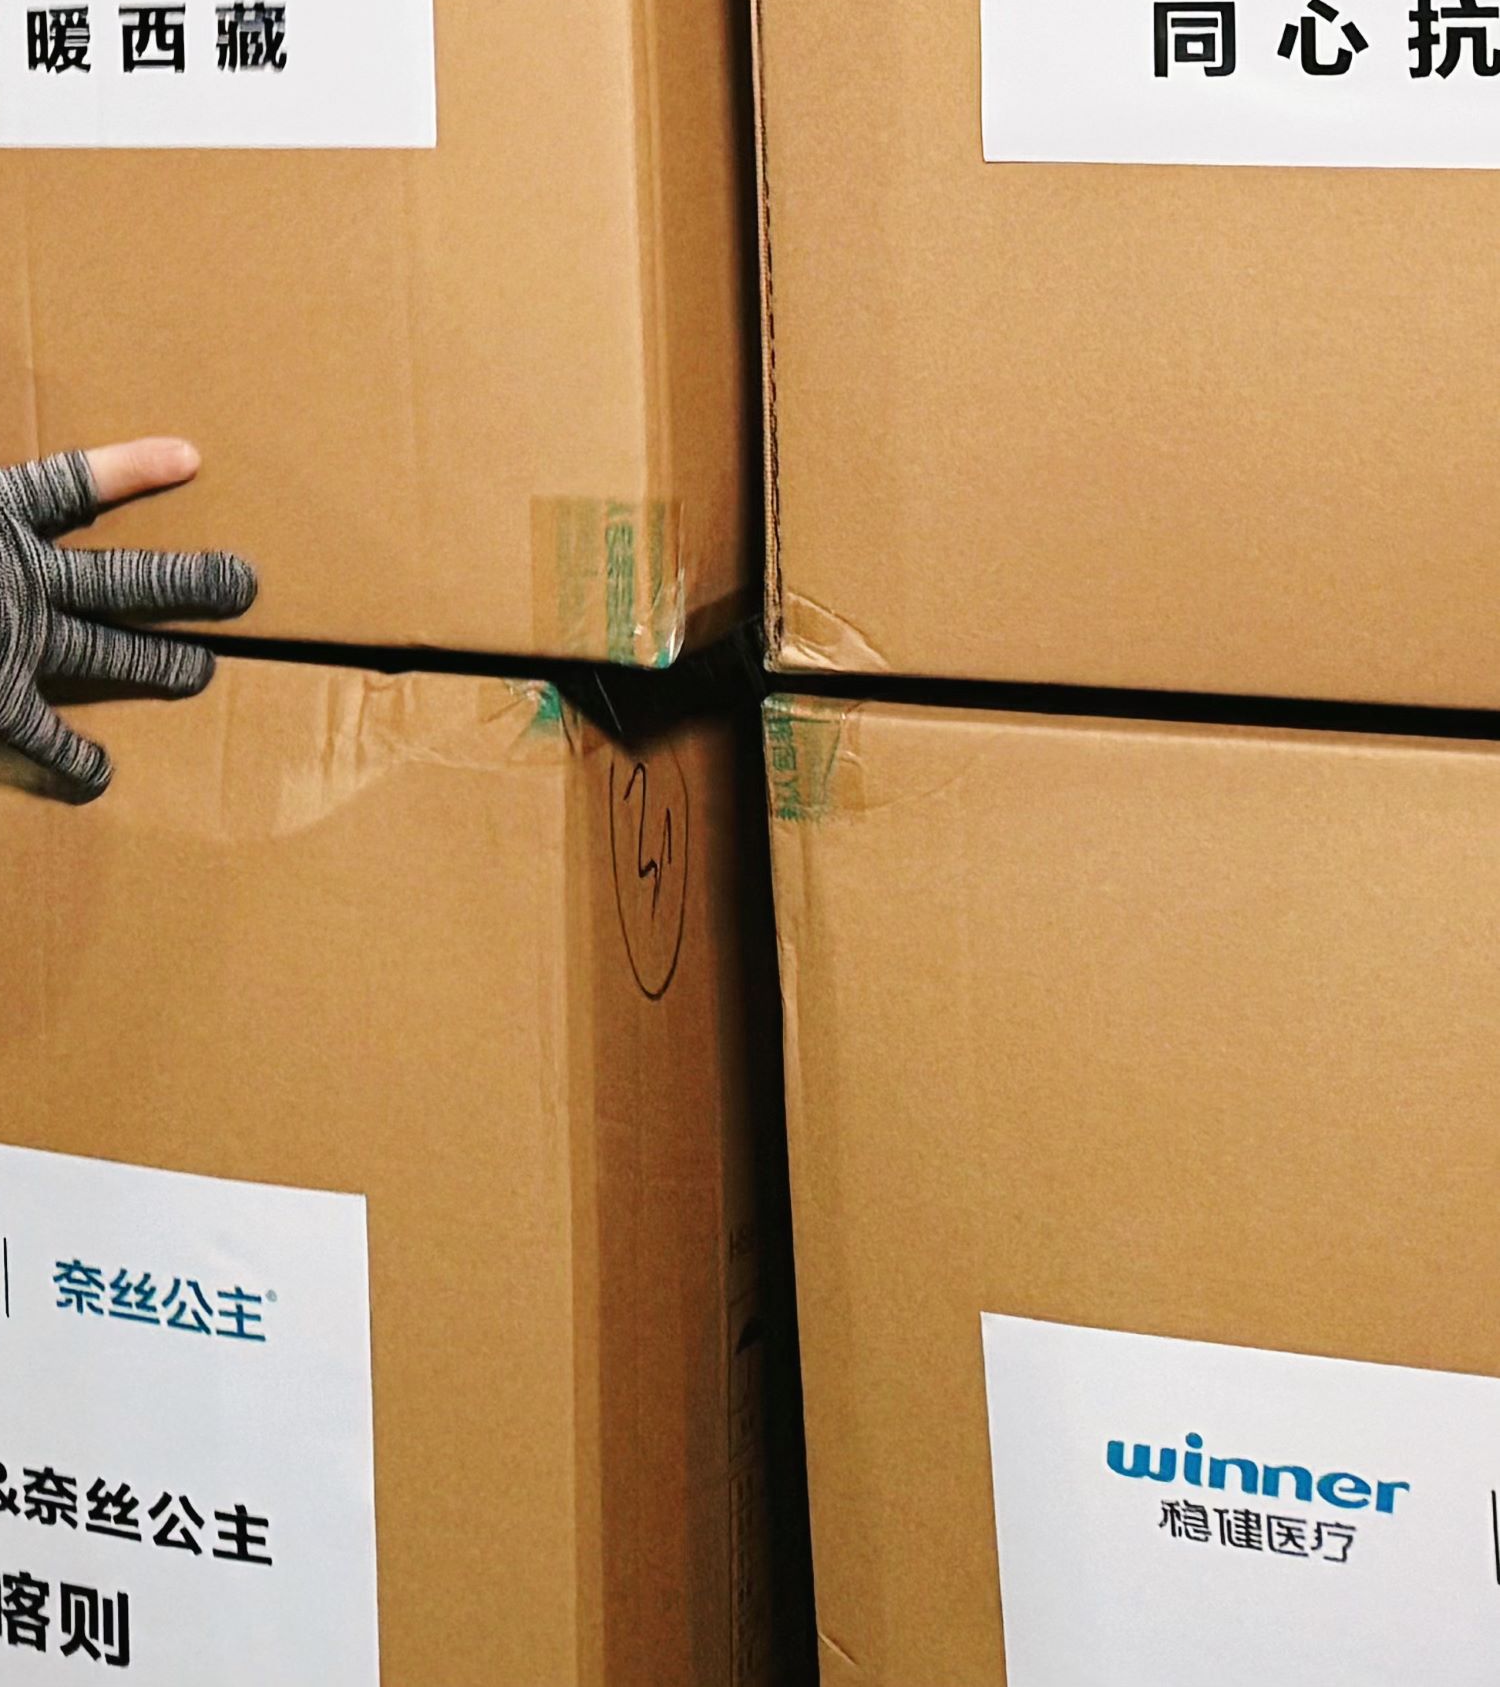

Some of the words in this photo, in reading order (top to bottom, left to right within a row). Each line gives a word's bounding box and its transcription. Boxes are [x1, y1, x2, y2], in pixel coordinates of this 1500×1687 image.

[52, 1259, 266, 1343] 奈丝公主
[1106, 1432, 1411, 1514] winner
[1158, 1499, 1357, 1563] 稳健医疗
